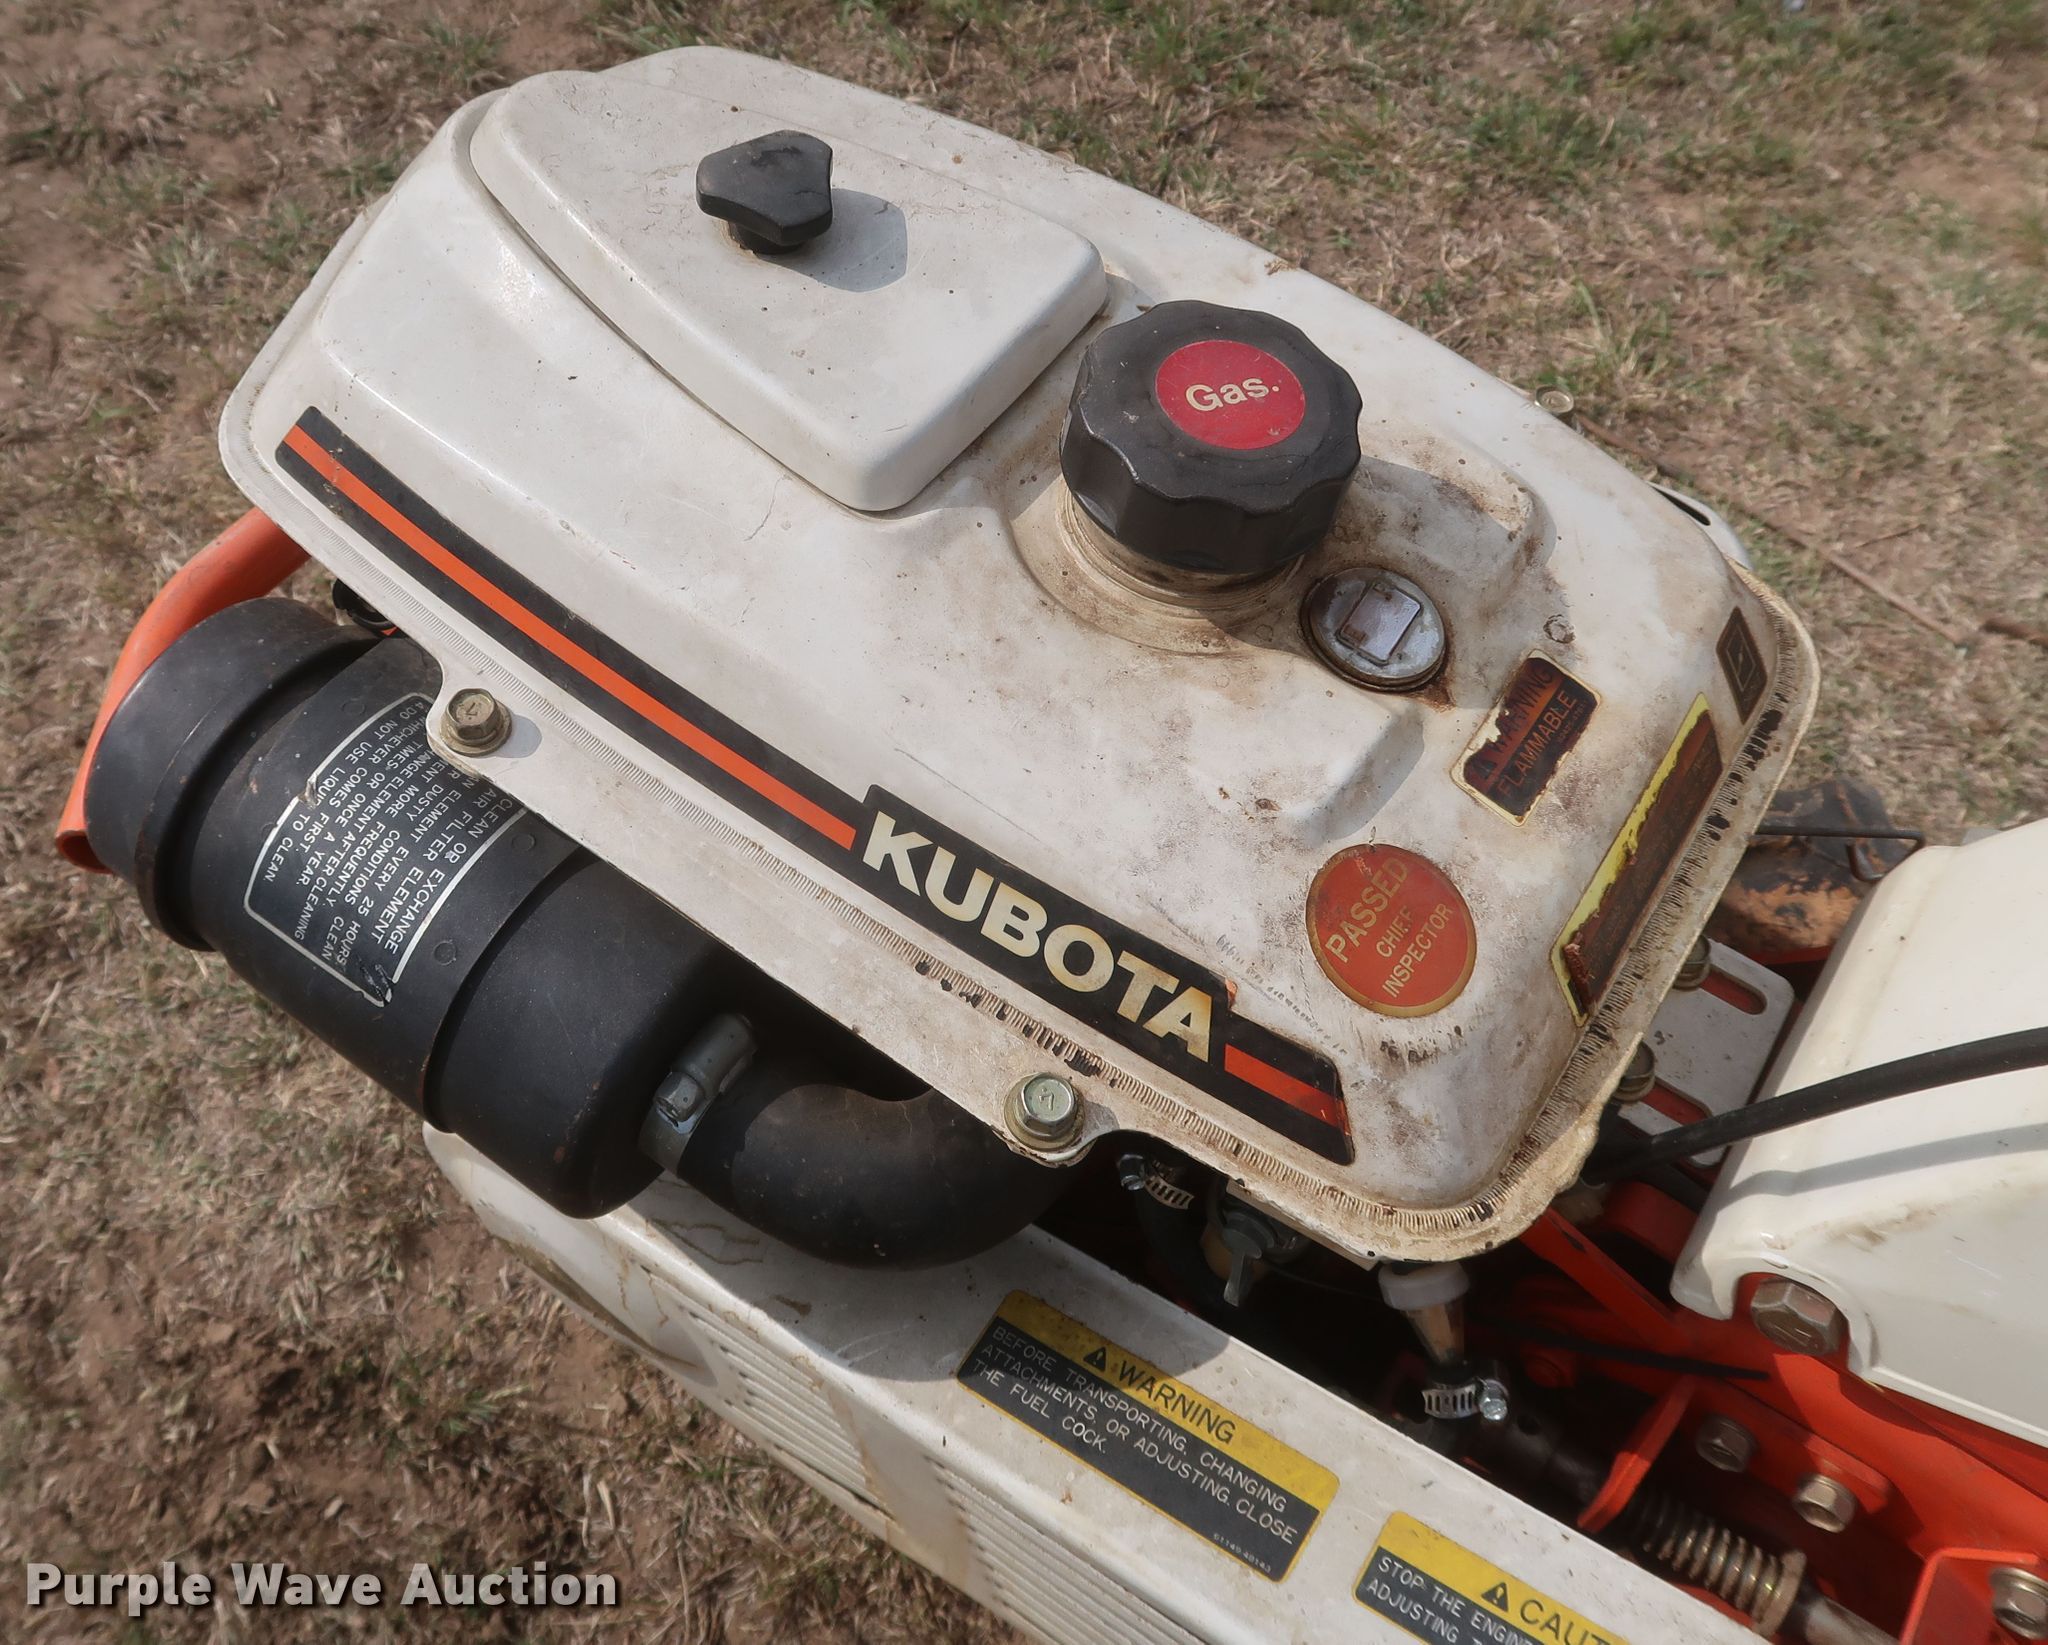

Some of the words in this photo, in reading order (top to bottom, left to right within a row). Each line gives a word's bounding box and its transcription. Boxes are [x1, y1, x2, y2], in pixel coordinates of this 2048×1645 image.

[1186, 377, 1280, 412] Gas.
[344, 739, 370, 764] USE
[372, 718, 396, 740] NOT
[1497, 690, 1577, 798] FLAMMABLE
[387, 739, 423, 770] TIMES
[328, 764, 367, 808] COMES
[366, 770, 386, 790] OR
[384, 783, 419, 818] MORE
[405, 782, 443, 821] DUSTY
[472, 787, 497, 808] AIR
[292, 811, 310, 832] TO
[334, 791, 366, 827] ONCE
[352, 775, 403, 832] ELEMENT
[408, 788, 461, 843] ELEMENT
[467, 797, 511, 839] CLEAN
[295, 812, 329, 855] FIRST.
[321, 830, 356, 876] AFTER
[323, 831, 336, 844] A
[422, 810, 471, 861] FILTER
[444, 840, 466, 864] OR
[295, 848, 325, 888] YEAR.
[322, 819, 385, 909] FREQUENTLY.
[343, 828, 401, 905] CONDITIONS
[372, 845, 408, 891] EVERY
[293, 875, 327, 940] CLEANING
[356, 895, 374, 916] 25
[368, 866, 423, 943] ELEMENT
[383, 868, 445, 954] EXCHANGE
[1325, 857, 1408, 963] PASSED
[320, 915, 345, 959] CLEAN
[861, 811, 1215, 1064] KUBOTA
[1376, 906, 1413, 958] CHIEF
[1382, 903, 1454, 998] INSPECTOR
[973, 1360, 1005, 1389] THE
[1009, 1384, 1050, 1419] FUEL
[1062, 1417, 1106, 1454] COCK.
[992, 1325, 1057, 1371] BEFORE
[1200, 1453, 1287, 1513] CHANGING
[1119, 1360, 1236, 1444] WARNING
[1106, 1421, 1130, 1442] OR
[1236, 1499, 1298, 1545] CLOSE
[1379, 1556, 1424, 1590] STOP
[1432, 1586, 1465, 1617] THE
[1366, 1578, 1458, 1645] ADJUSTING
